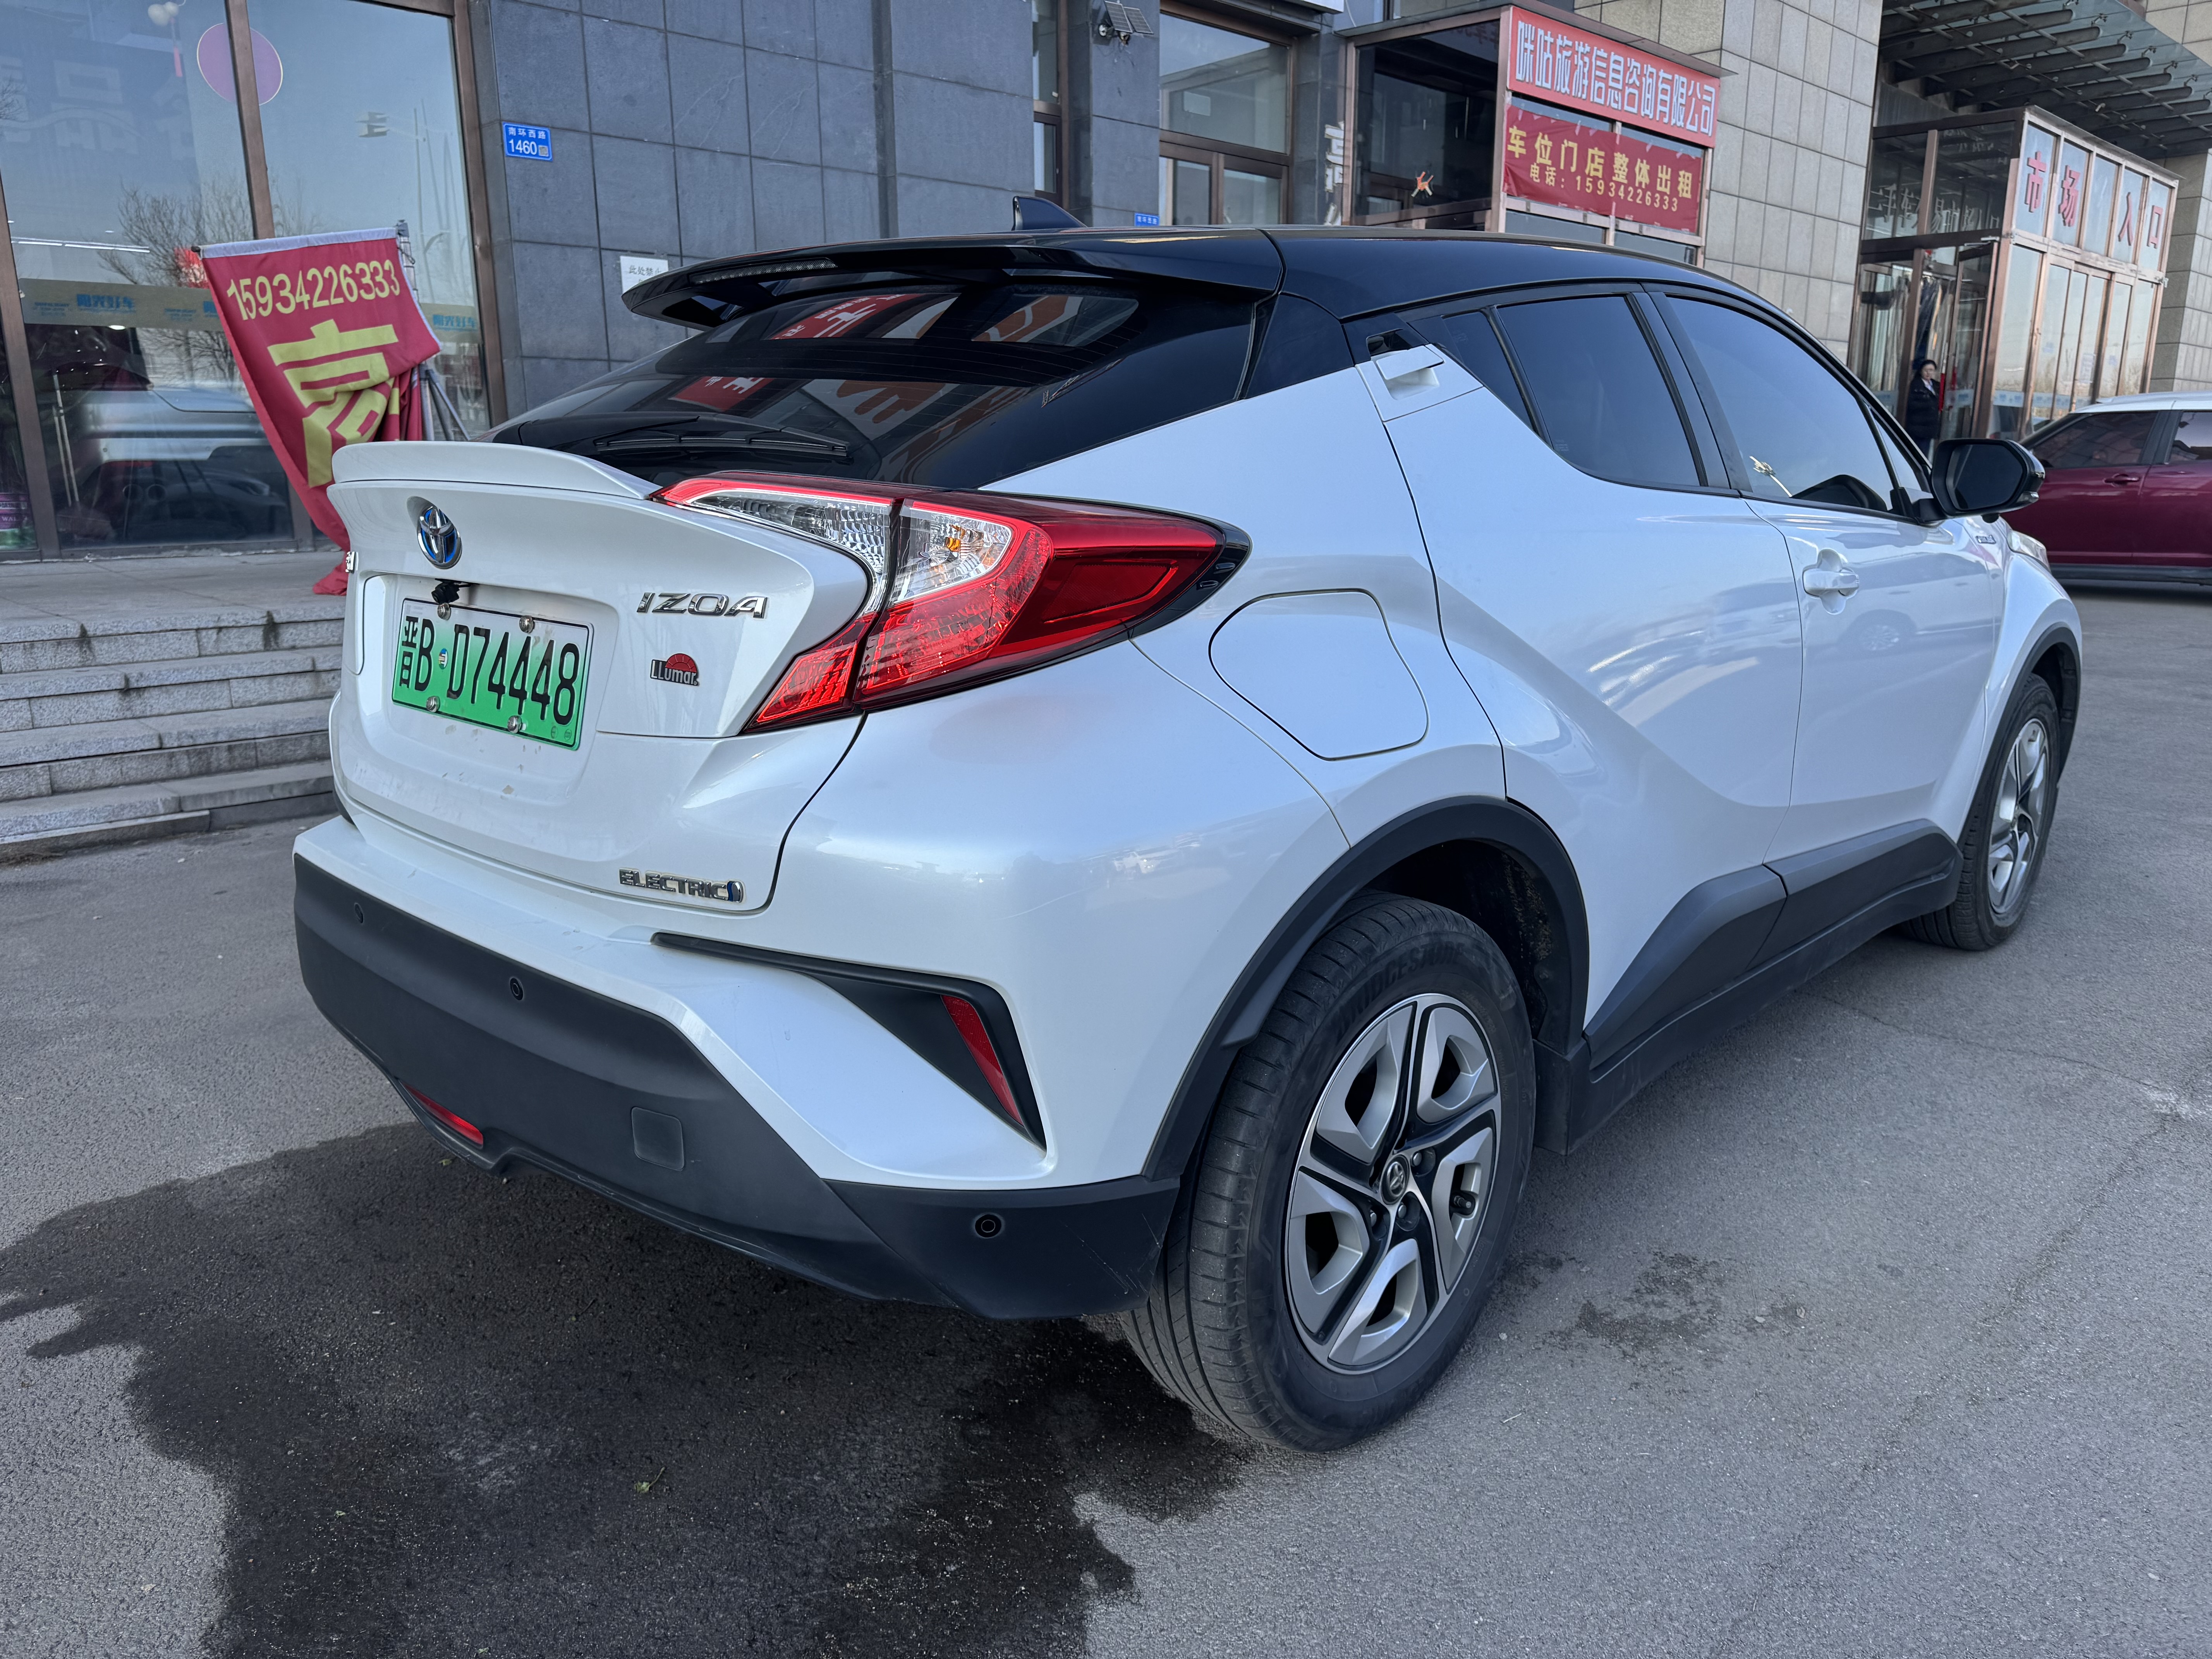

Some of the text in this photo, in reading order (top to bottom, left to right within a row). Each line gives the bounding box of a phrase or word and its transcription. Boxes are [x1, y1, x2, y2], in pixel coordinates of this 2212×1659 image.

[1516, 21, 1716, 137] 咪咕旅游信息咨询有限公司
[508, 127, 546, 139] 南环西路
[509, 139, 537, 155] 1460
[1507, 126, 1692, 199] 车位门店整体出租
[227, 259, 400, 321] 15934226333
[637, 592, 769, 619] IZOA
[619, 869, 727, 901] ELECTRIC
